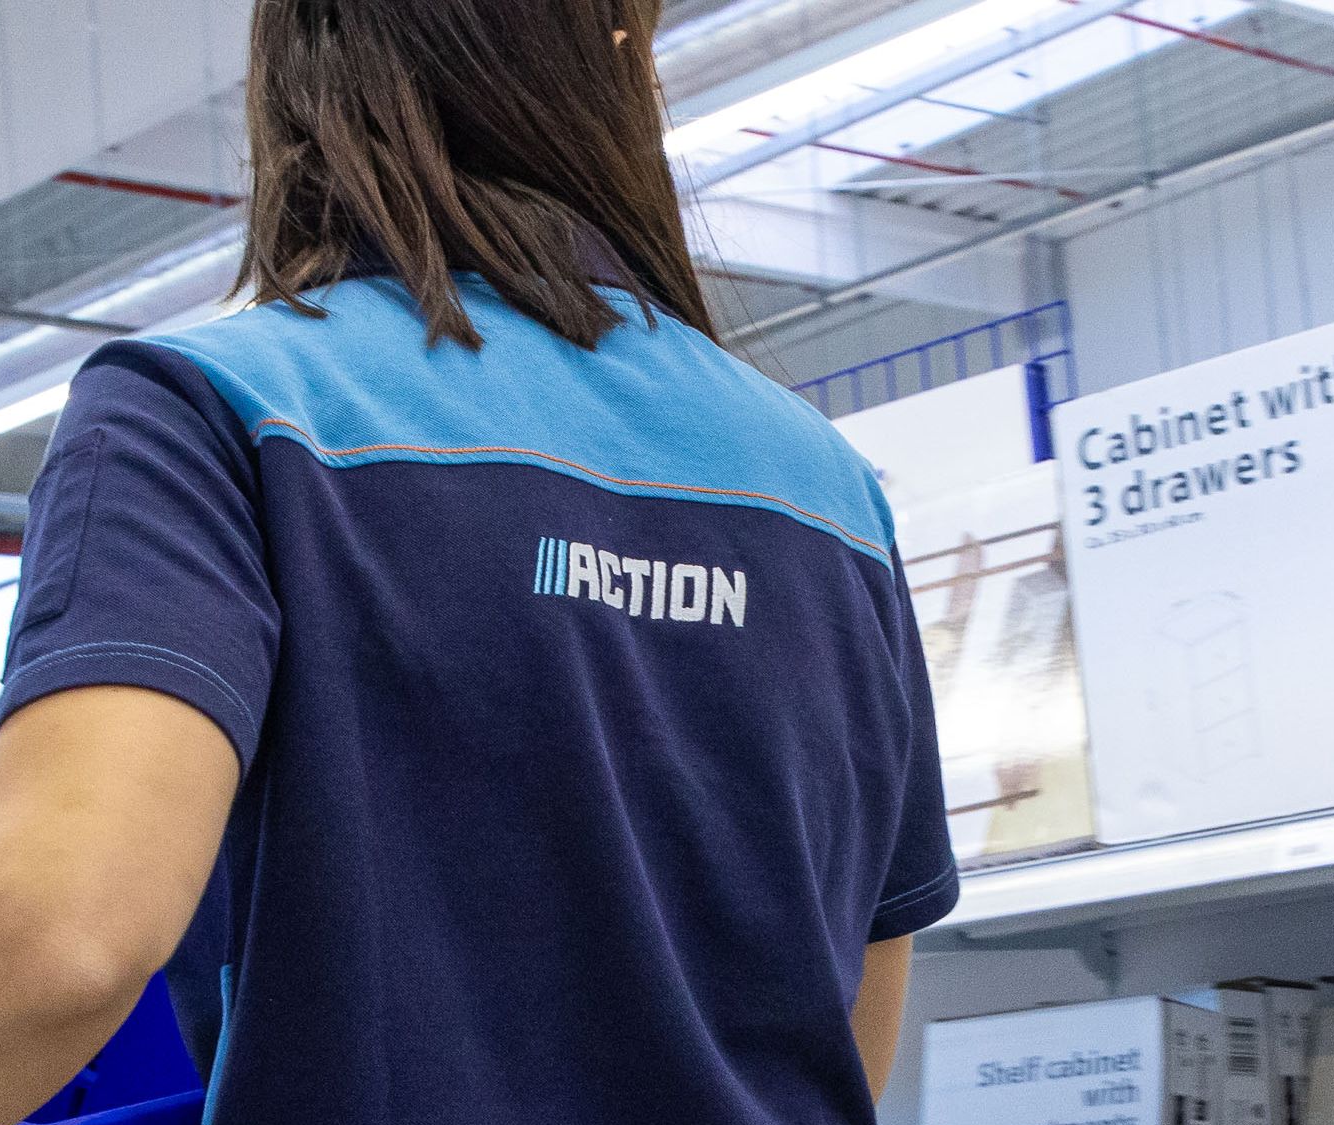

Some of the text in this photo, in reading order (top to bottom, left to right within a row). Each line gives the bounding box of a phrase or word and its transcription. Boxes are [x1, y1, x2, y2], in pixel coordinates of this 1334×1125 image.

[1076, 391, 1252, 470] Cabinet
[1083, 440, 1303, 526] 3 drawers
[567, 541, 746, 628] ACTION
[976, 1048, 1141, 1088] Shelf cabinet
[1082, 1077, 1139, 1106] with
